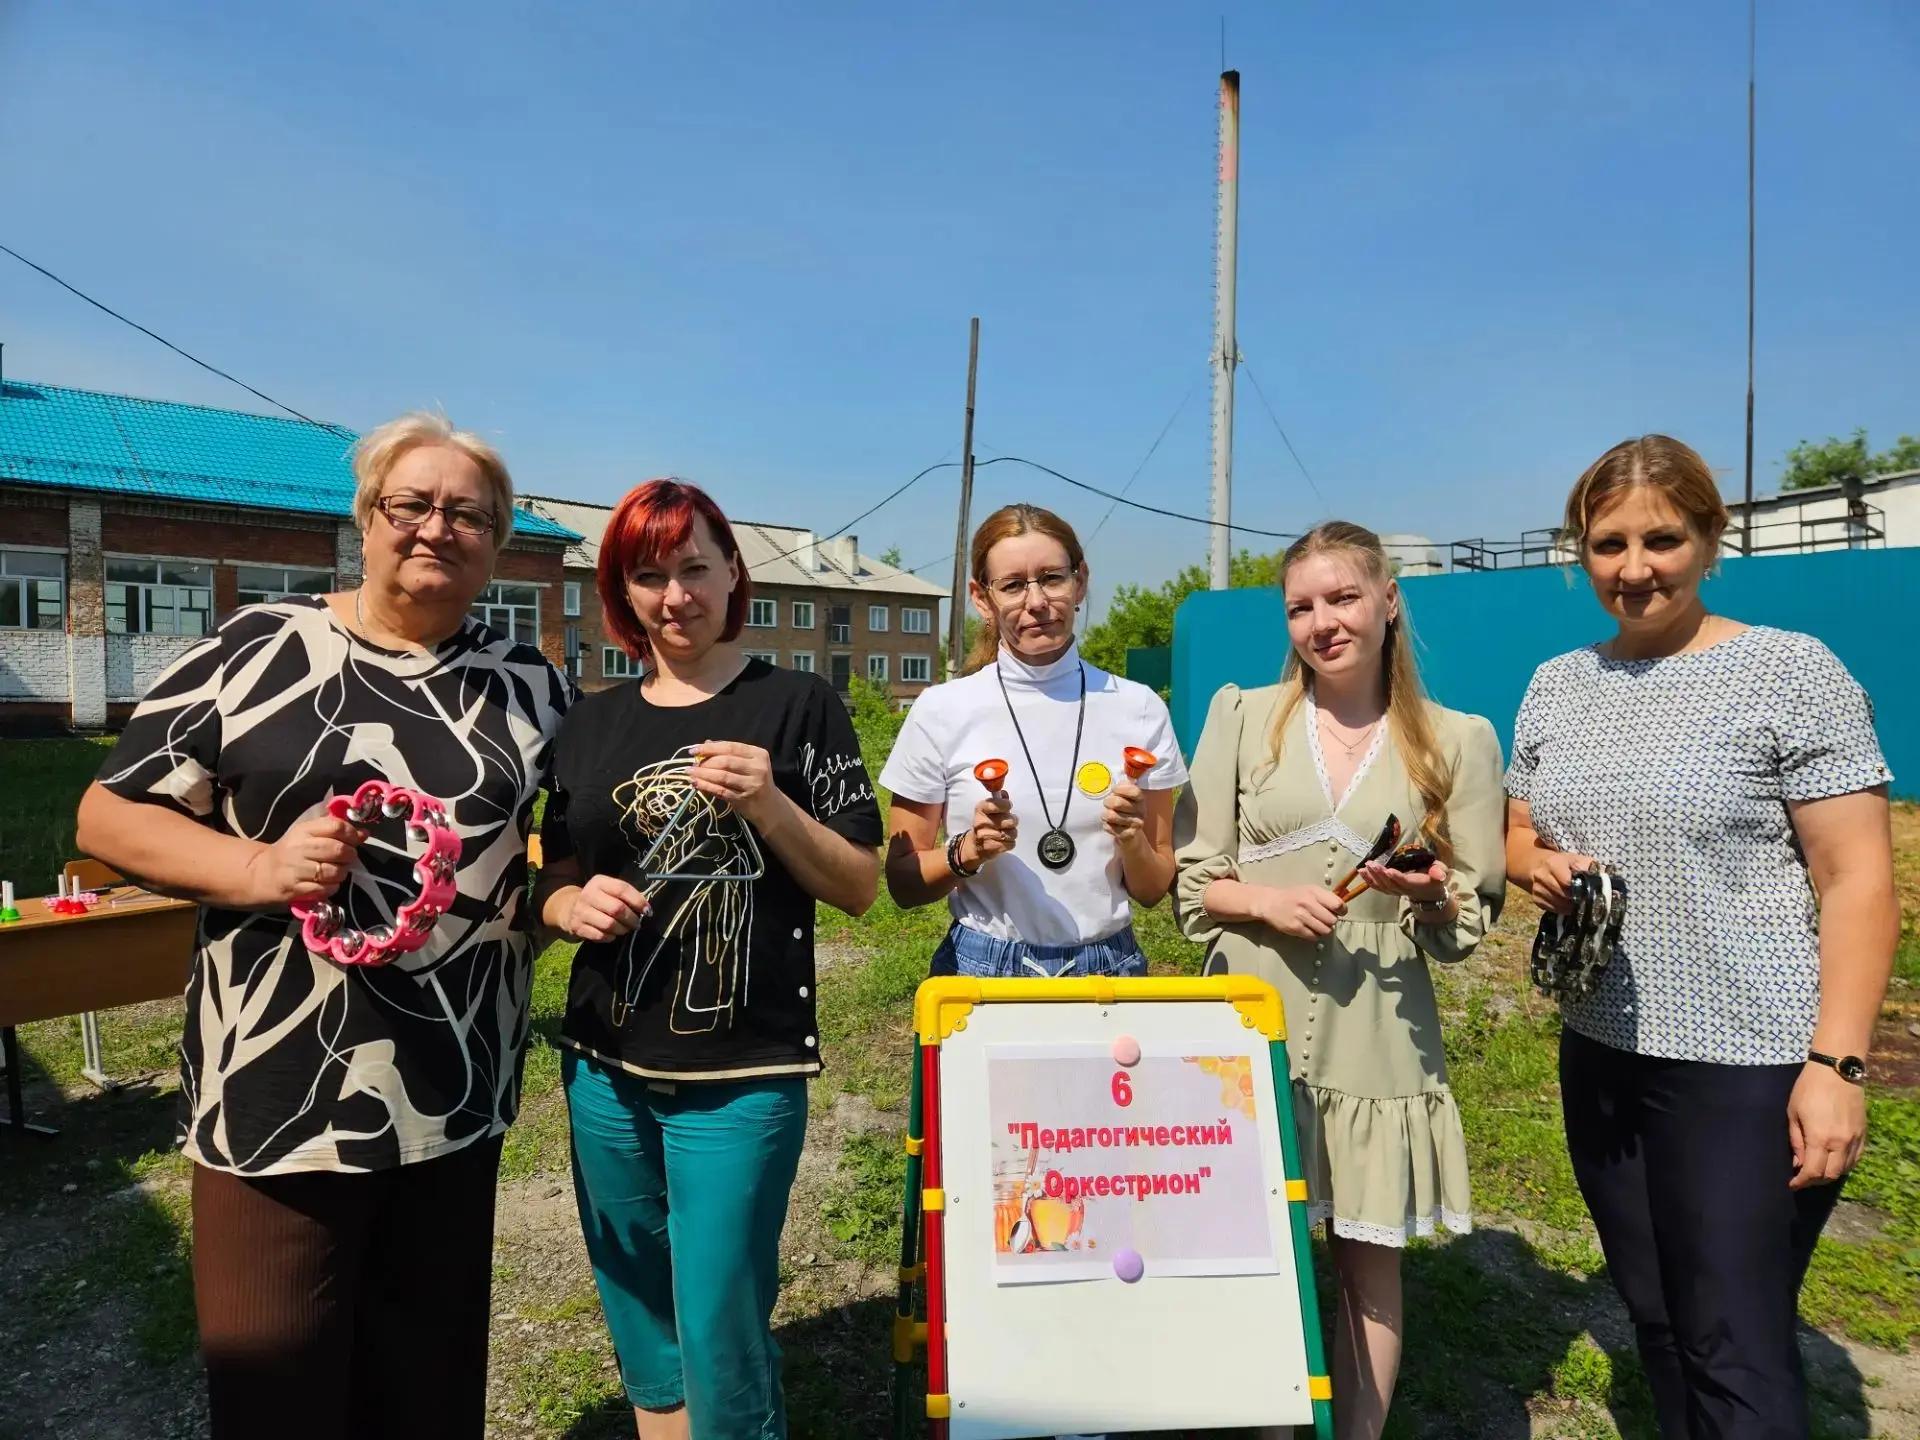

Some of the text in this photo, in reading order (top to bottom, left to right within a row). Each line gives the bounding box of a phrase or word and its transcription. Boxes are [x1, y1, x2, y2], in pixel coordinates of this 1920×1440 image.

[1111, 1071, 1133, 1107] 6
[1007, 1118, 1233, 1153] "Педагогический
[1044, 1166, 1212, 1202] Оркестрион"
